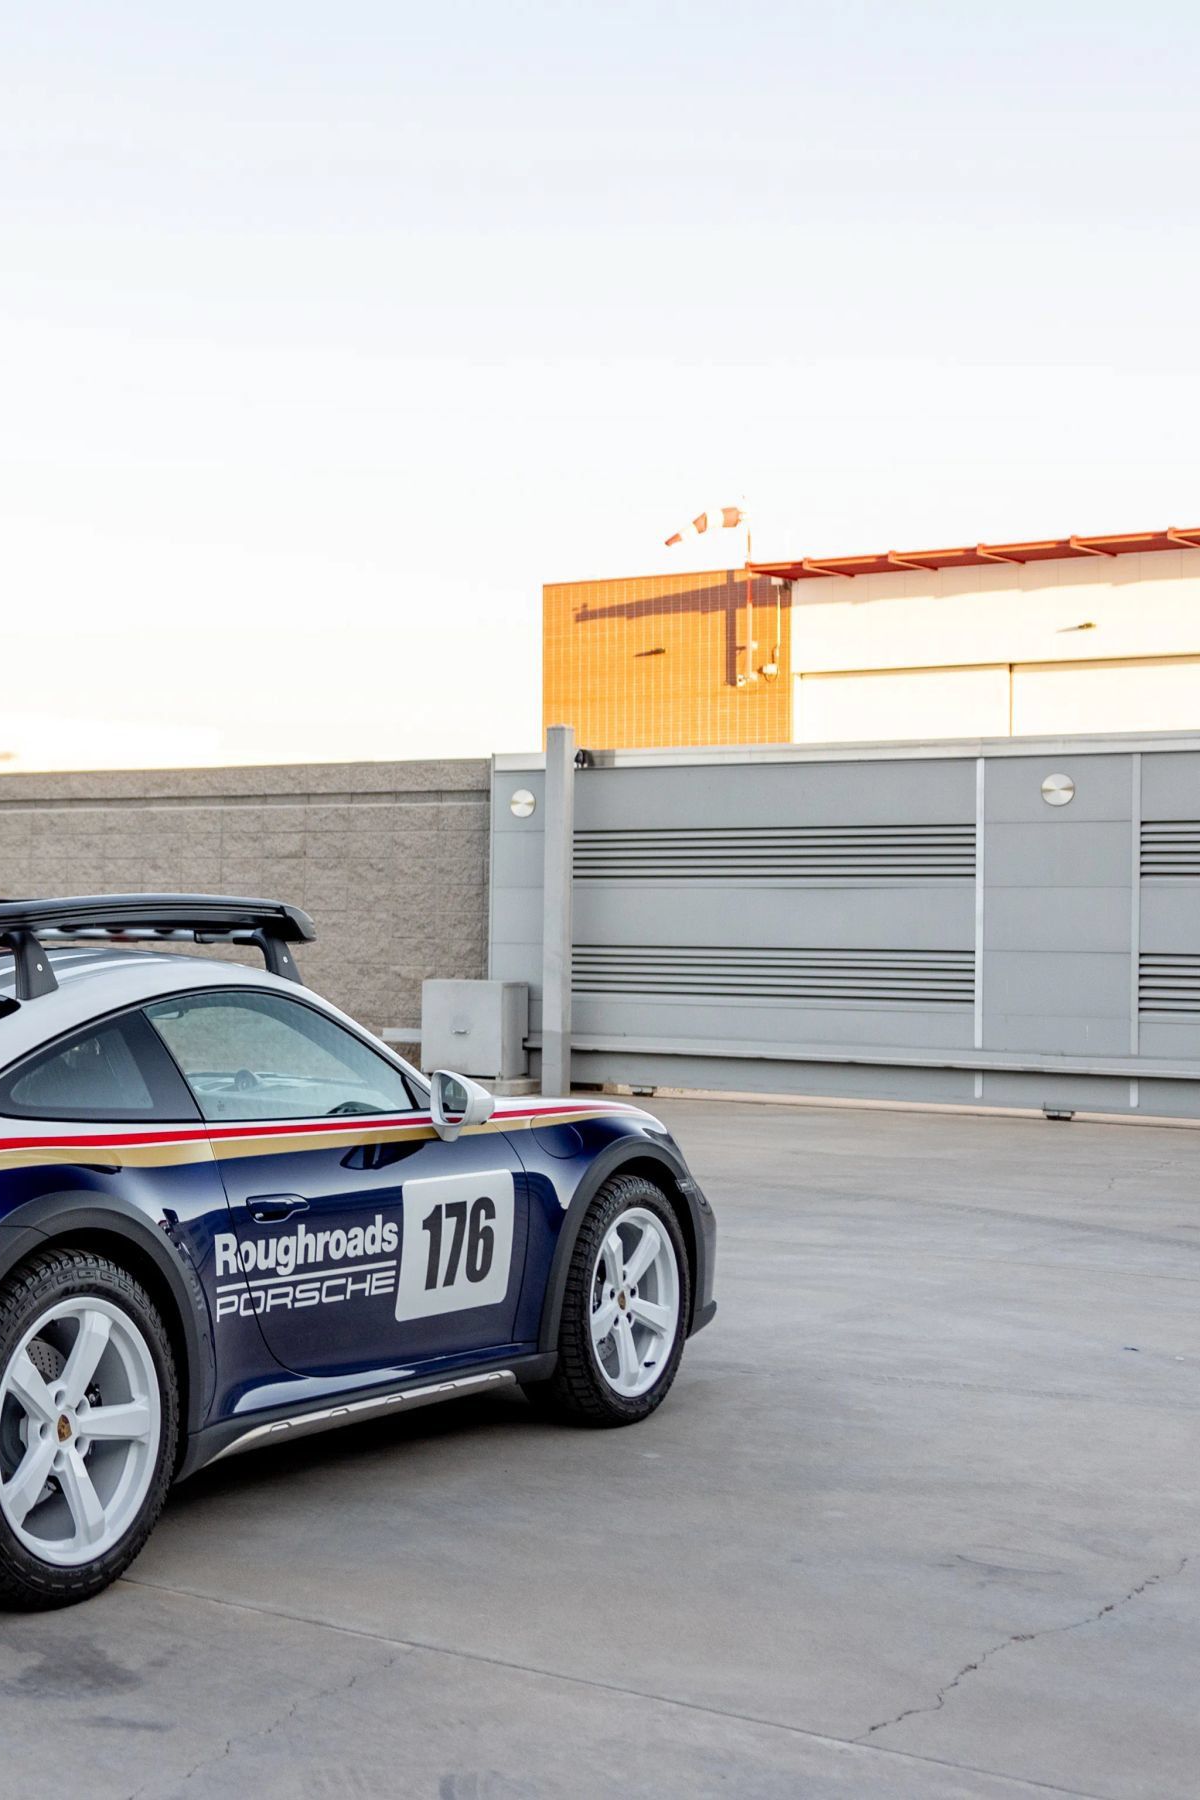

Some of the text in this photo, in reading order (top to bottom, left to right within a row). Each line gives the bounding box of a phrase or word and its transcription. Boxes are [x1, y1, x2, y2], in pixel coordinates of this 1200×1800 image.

[214, 1214, 399, 1277] Roughroads
[422, 1196, 496, 1291] 176
[216, 1270, 396, 1323] PORSCHE
